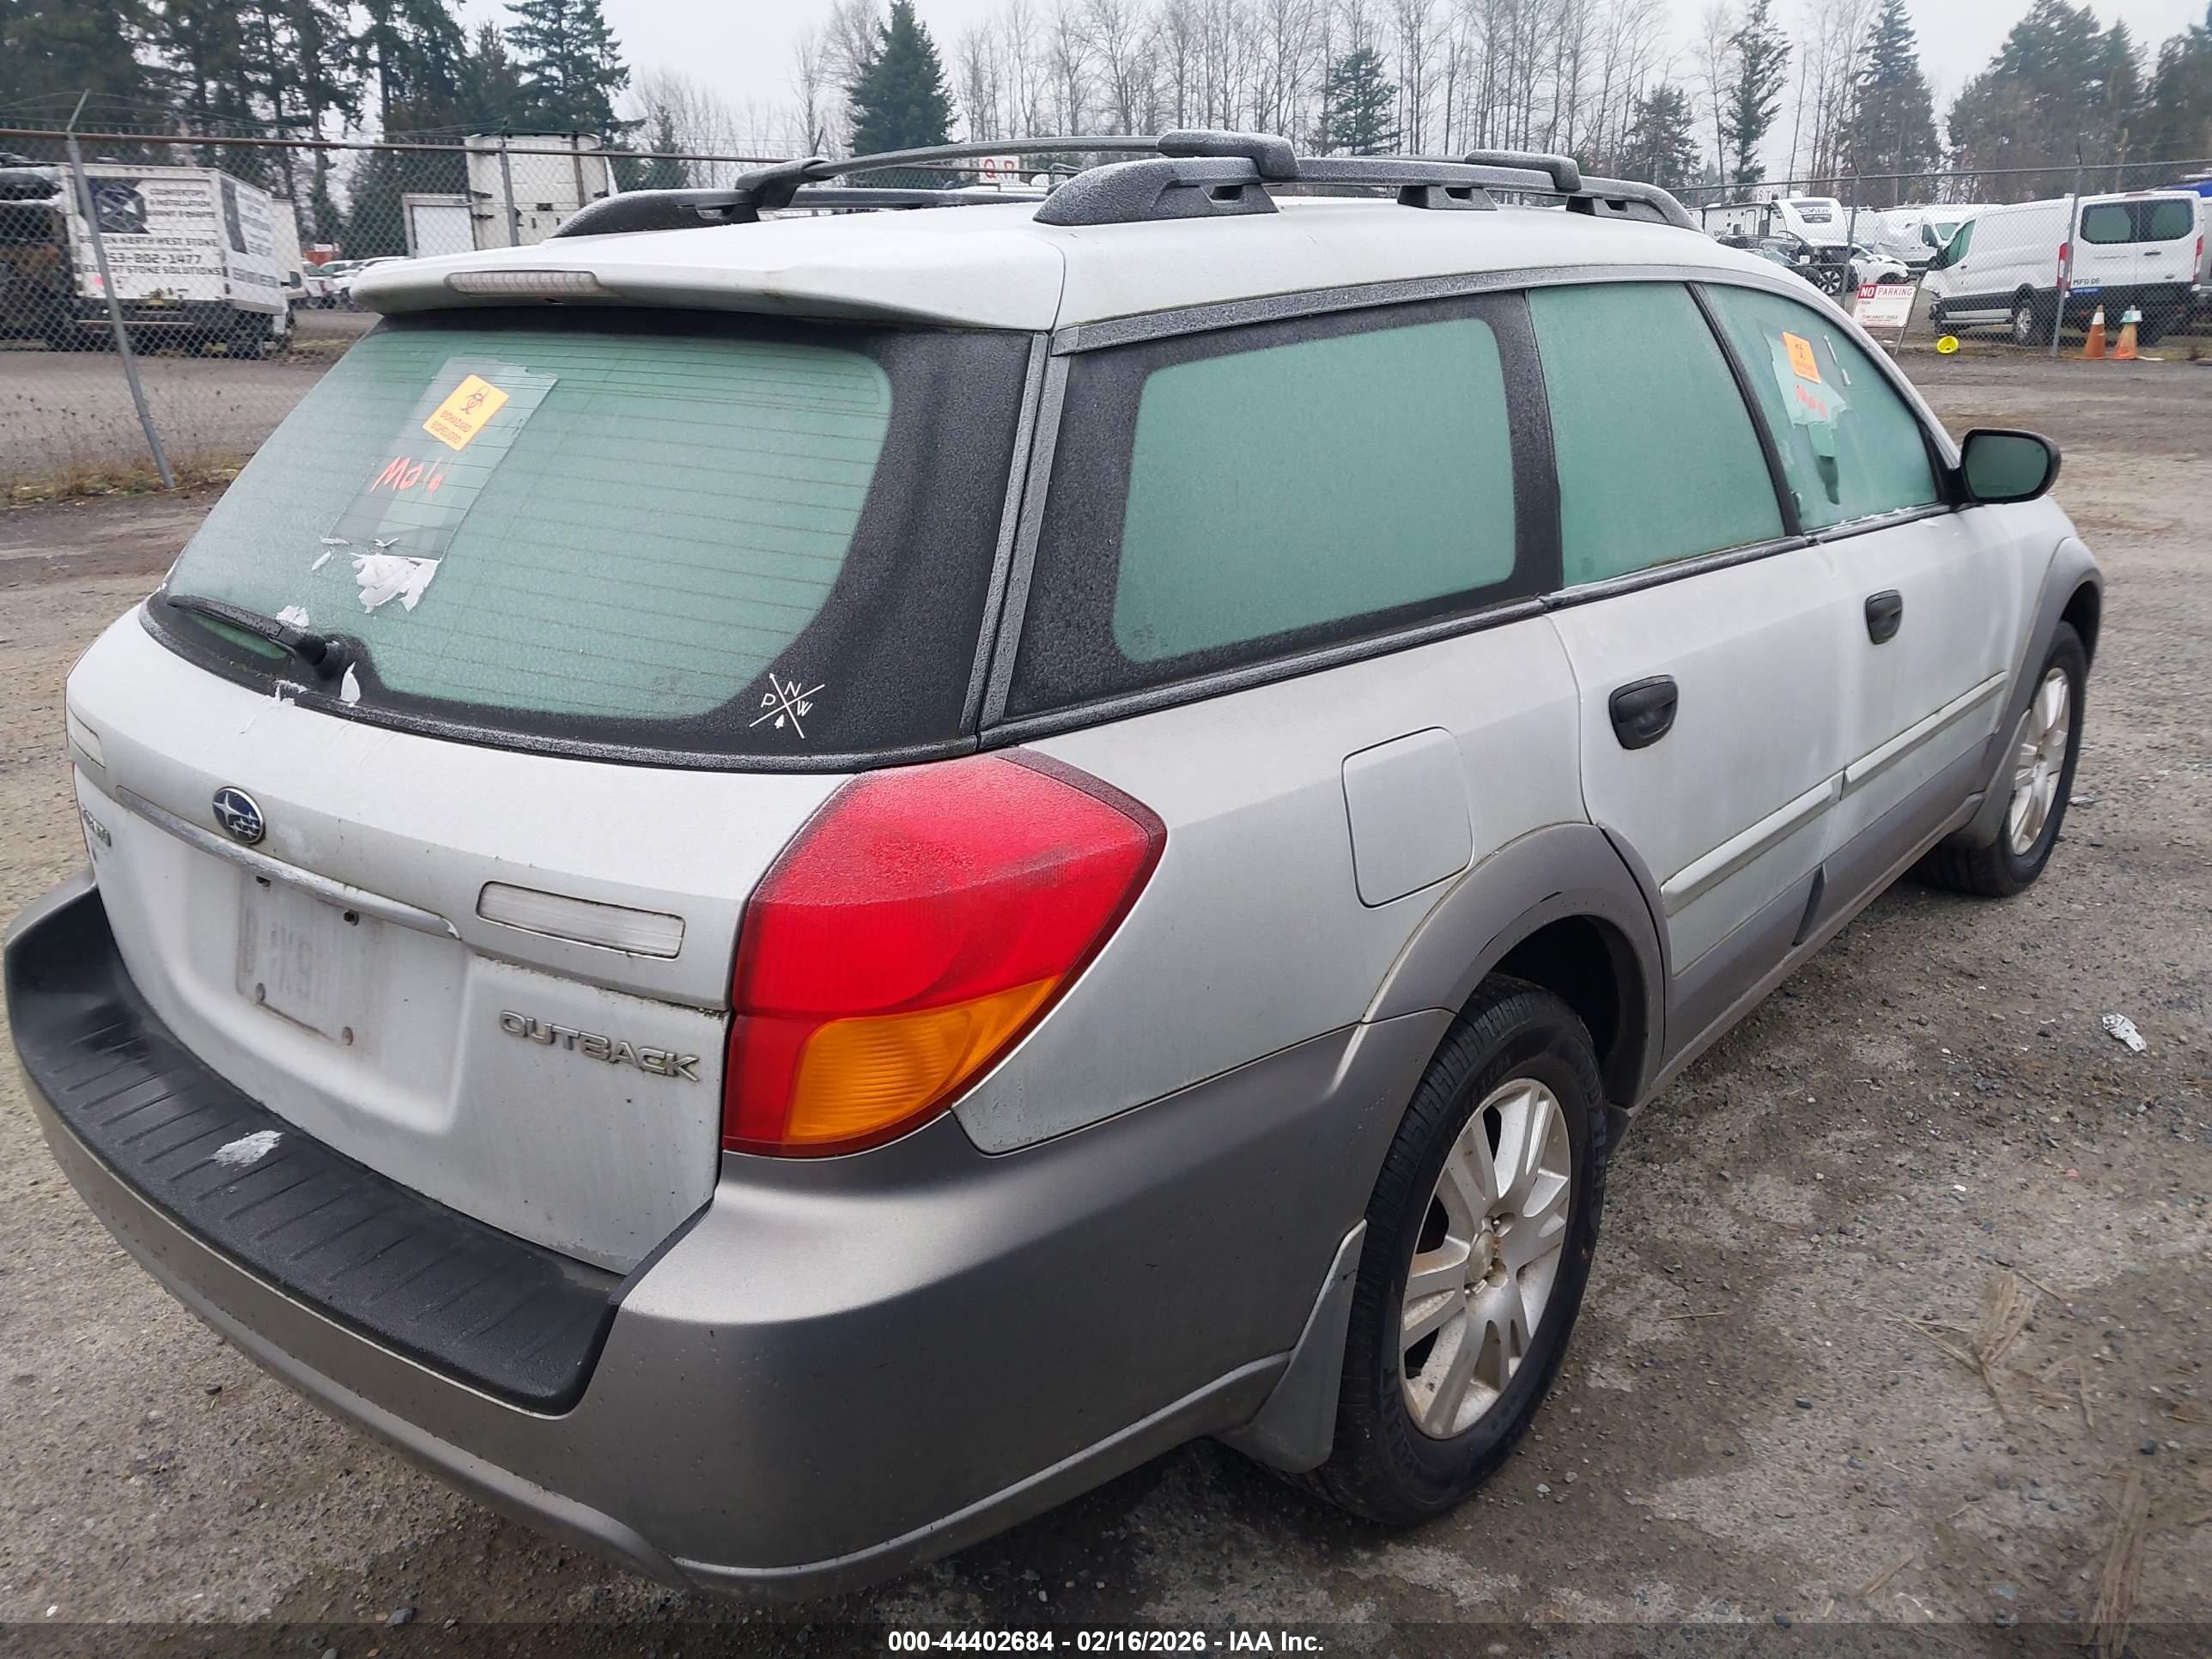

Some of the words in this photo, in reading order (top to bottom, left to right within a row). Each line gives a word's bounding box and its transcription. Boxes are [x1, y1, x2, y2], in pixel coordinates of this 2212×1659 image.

[156, 237, 183, 246] WEST
[186, 238, 219, 247] STONE
[108, 252, 203, 264] 53-802-1477
[127, 264, 162, 275] STONE
[164, 265, 222, 276] SOLUTIONS
[1860, 286, 1875, 298] NO
[1877, 287, 1913, 297] PARKING
[440, 410, 472, 433] BIOHAZARD
[496, 1010, 701, 1083] OUTBACK
